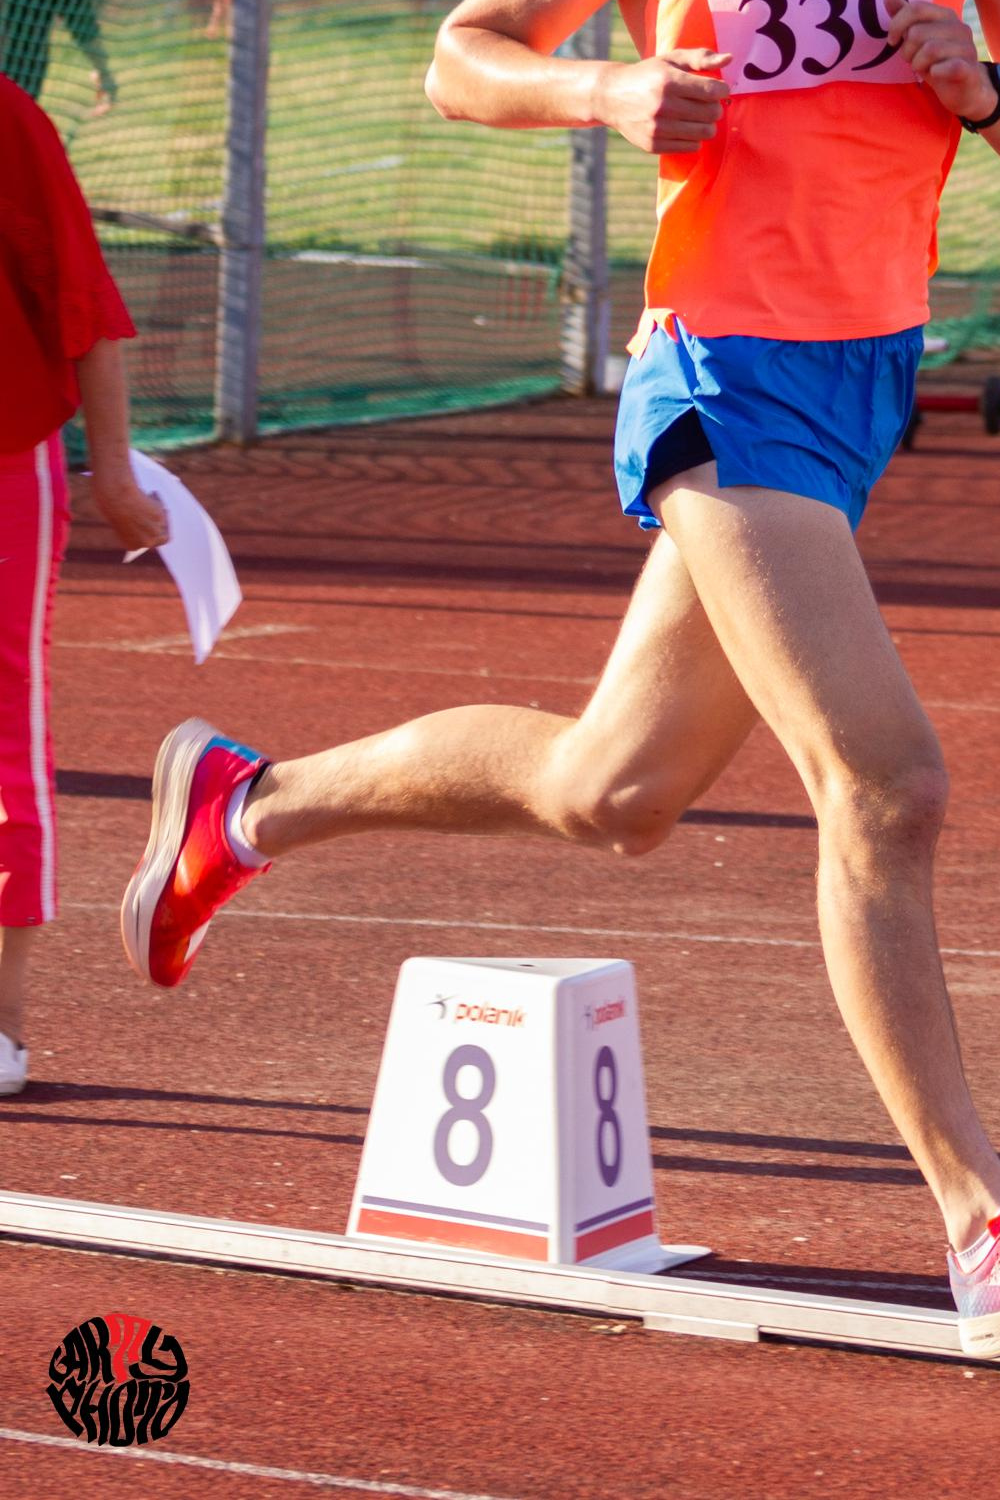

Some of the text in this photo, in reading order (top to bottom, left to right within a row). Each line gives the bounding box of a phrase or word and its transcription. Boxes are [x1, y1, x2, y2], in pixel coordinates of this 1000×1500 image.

[454, 1002, 527, 1027] polanik
[433, 1044, 496, 1186] 8
[595, 1045, 621, 1187] 8
